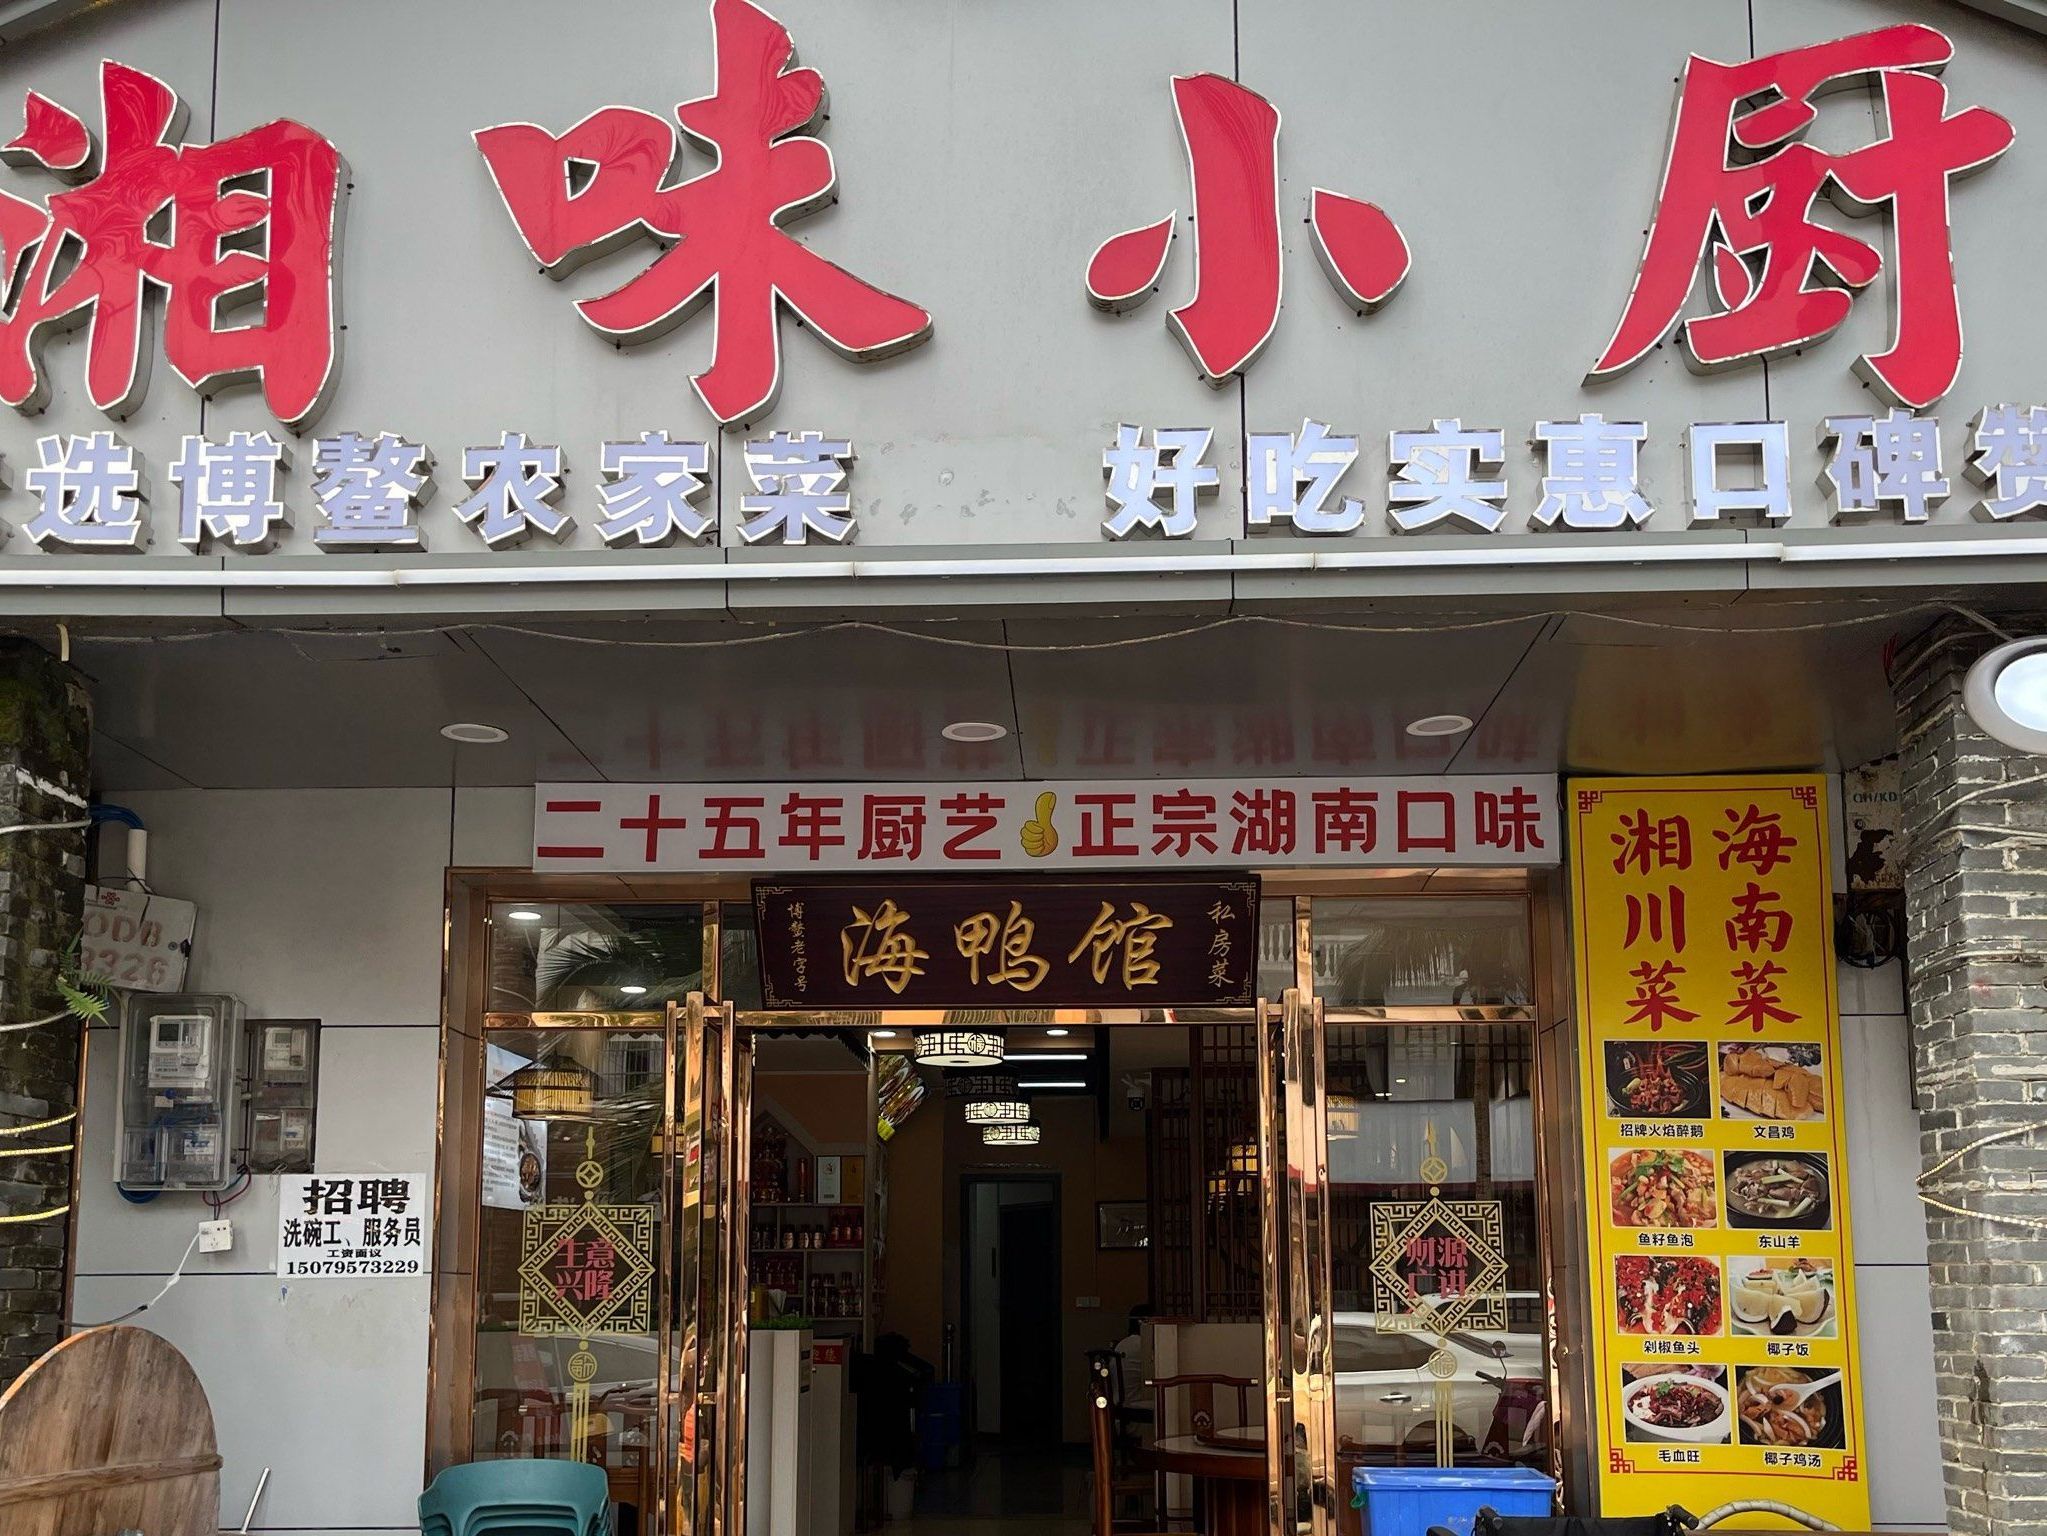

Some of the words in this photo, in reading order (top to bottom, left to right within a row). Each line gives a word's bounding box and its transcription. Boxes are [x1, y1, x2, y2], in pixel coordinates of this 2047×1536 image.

[0, 0, 2016, 424] 湘味小厨
[537, 792, 1006, 861] 二十五年厨艺
[1071, 786, 1545, 858] 正宗湖南口味
[1610, 808, 1701, 1033] 湘川菜
[1712, 803, 1803, 1033] 海南菜
[840, 898, 1174, 994] 海鸭馆
[1206, 900, 1236, 988] 私房菜
[1620, 1123, 1704, 1138] 招牌火焰醉鹅
[1753, 1125, 1796, 1140] 文昌鸡
[302, 1178, 411, 1216] 招聘
[283, 1217, 421, 1248] 洗碗工、服务员
[1638, 1232, 1695, 1247] 鱼籽鱼泡
[1758, 1234, 1801, 1249] 东山羊
[326, 1248, 382, 1259] 工资面议
[555, 1238, 615, 1268] 生意
[1406, 1237, 1469, 1267] 财源
[287, 1260, 419, 1275] 15079573229
[555, 1269, 615, 1301] 兴隆
[1406, 1268, 1468, 1300] 广进
[1644, 1340, 1701, 1356] 剁椒鱼头
[1767, 1342, 1810, 1357] 椰子饭
[1658, 1449, 1701, 1463] 毛血旺
[1764, 1452, 1822, 1468] 椰子鸡汤
